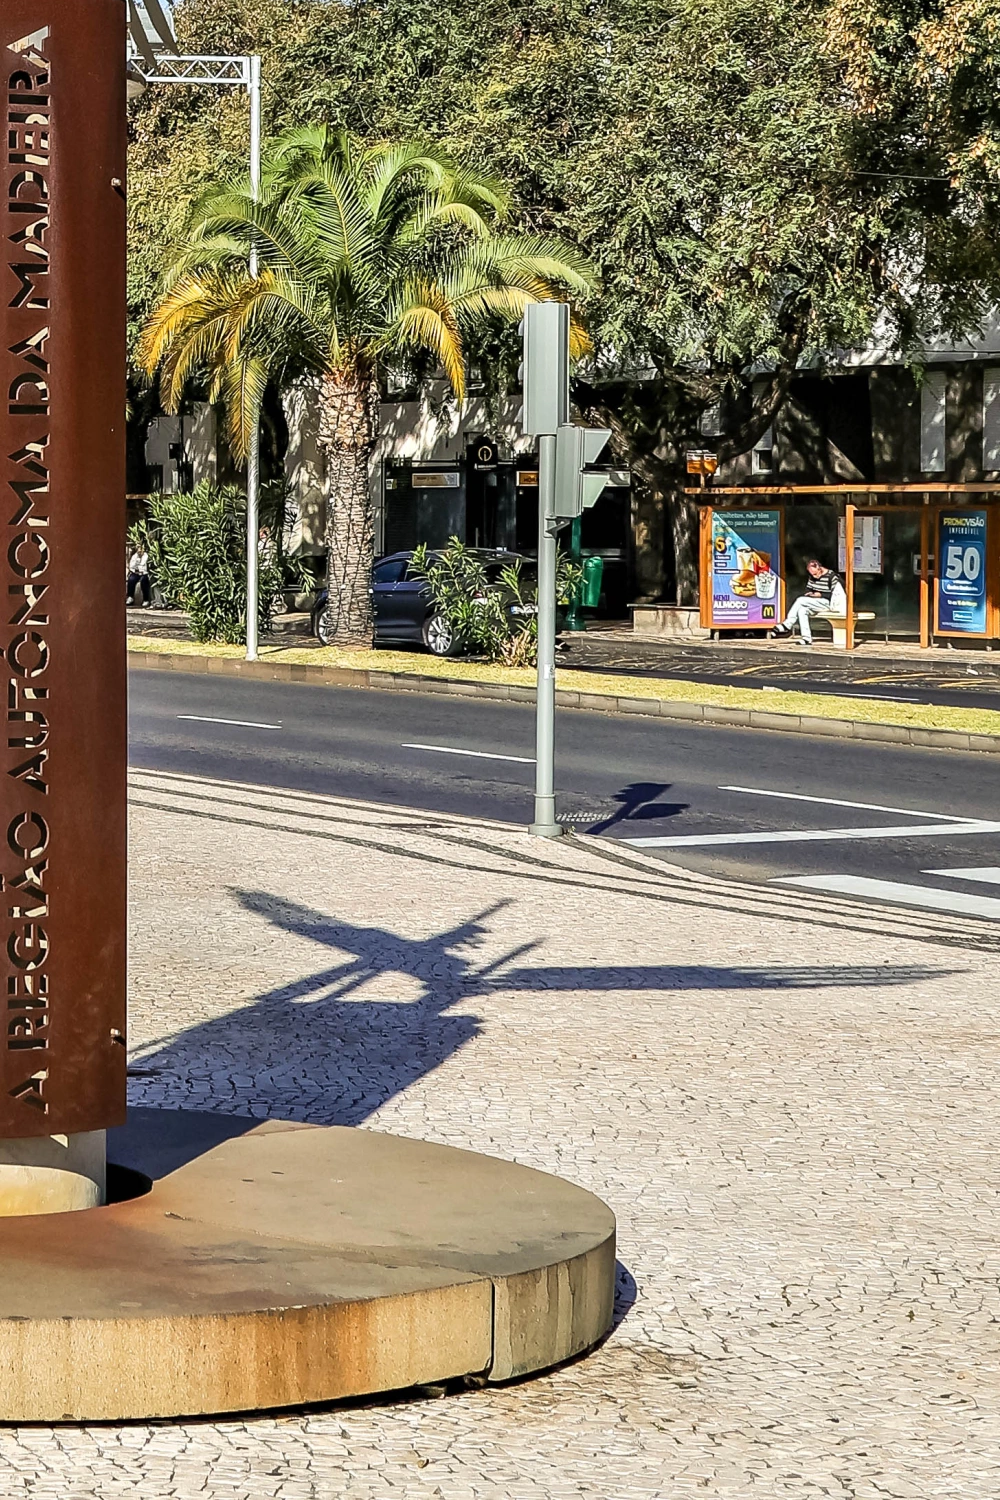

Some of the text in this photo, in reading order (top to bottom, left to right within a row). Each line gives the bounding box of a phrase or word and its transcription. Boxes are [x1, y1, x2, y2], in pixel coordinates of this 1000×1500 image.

[4, 24, 51, 310] MADEIRA
[5, 325, 51, 417] DA
[946, 546, 981, 580] 50
[713, 601, 748, 610] ALMOÇO
[5, 1066, 51, 1115] A
